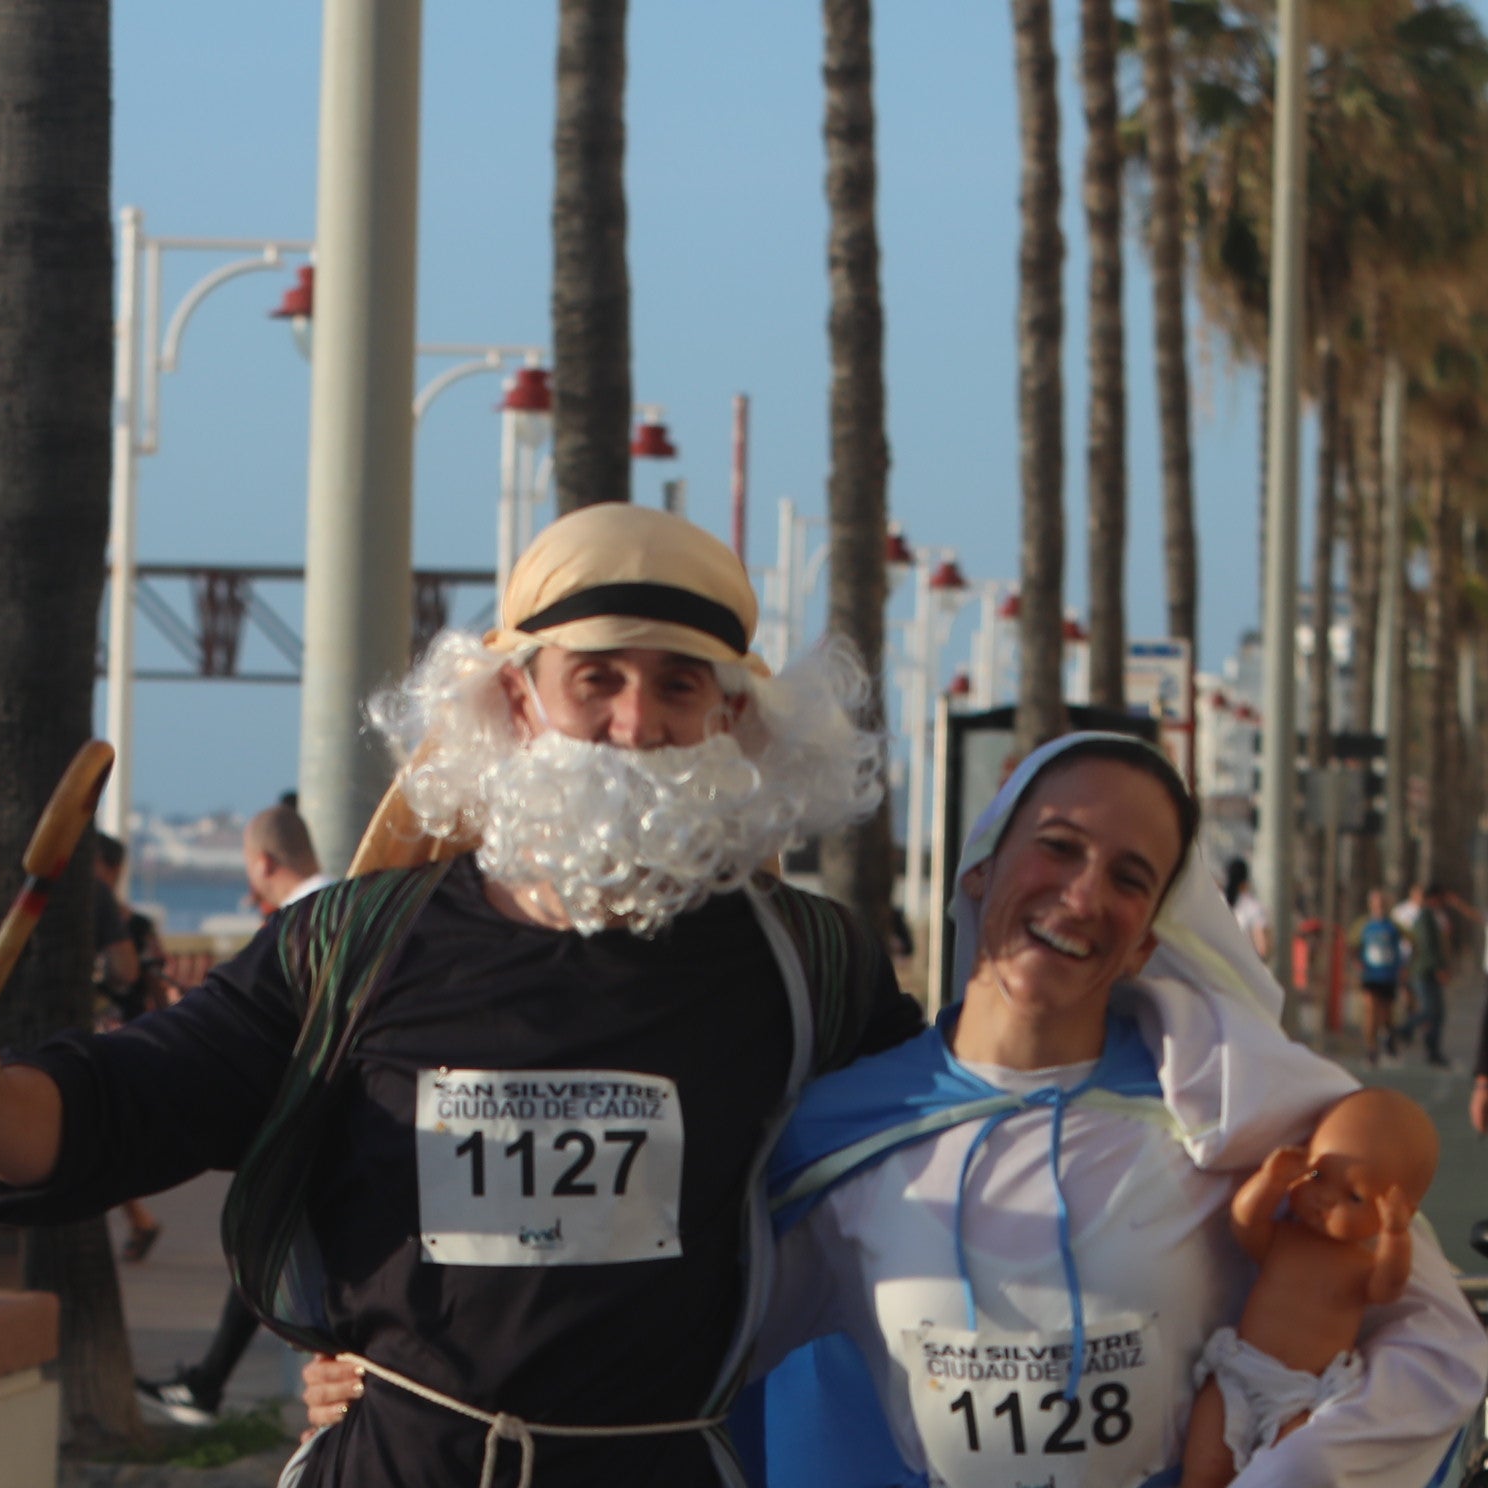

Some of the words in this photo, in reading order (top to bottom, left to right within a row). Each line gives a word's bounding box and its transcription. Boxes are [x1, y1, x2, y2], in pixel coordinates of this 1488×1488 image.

[438, 1082, 494, 1099] SAN
[504, 1081, 660, 1100] SILVESTRE
[437, 1101, 536, 1120] CIUDAD
[544, 1101, 577, 1120] DE
[456, 1130, 648, 1197] 1127
[922, 1341, 978, 1360] SAN
[926, 1358, 1019, 1382] CIUDAD
[1025, 1361, 1061, 1383] DE
[950, 1381, 1132, 1455] 1128
